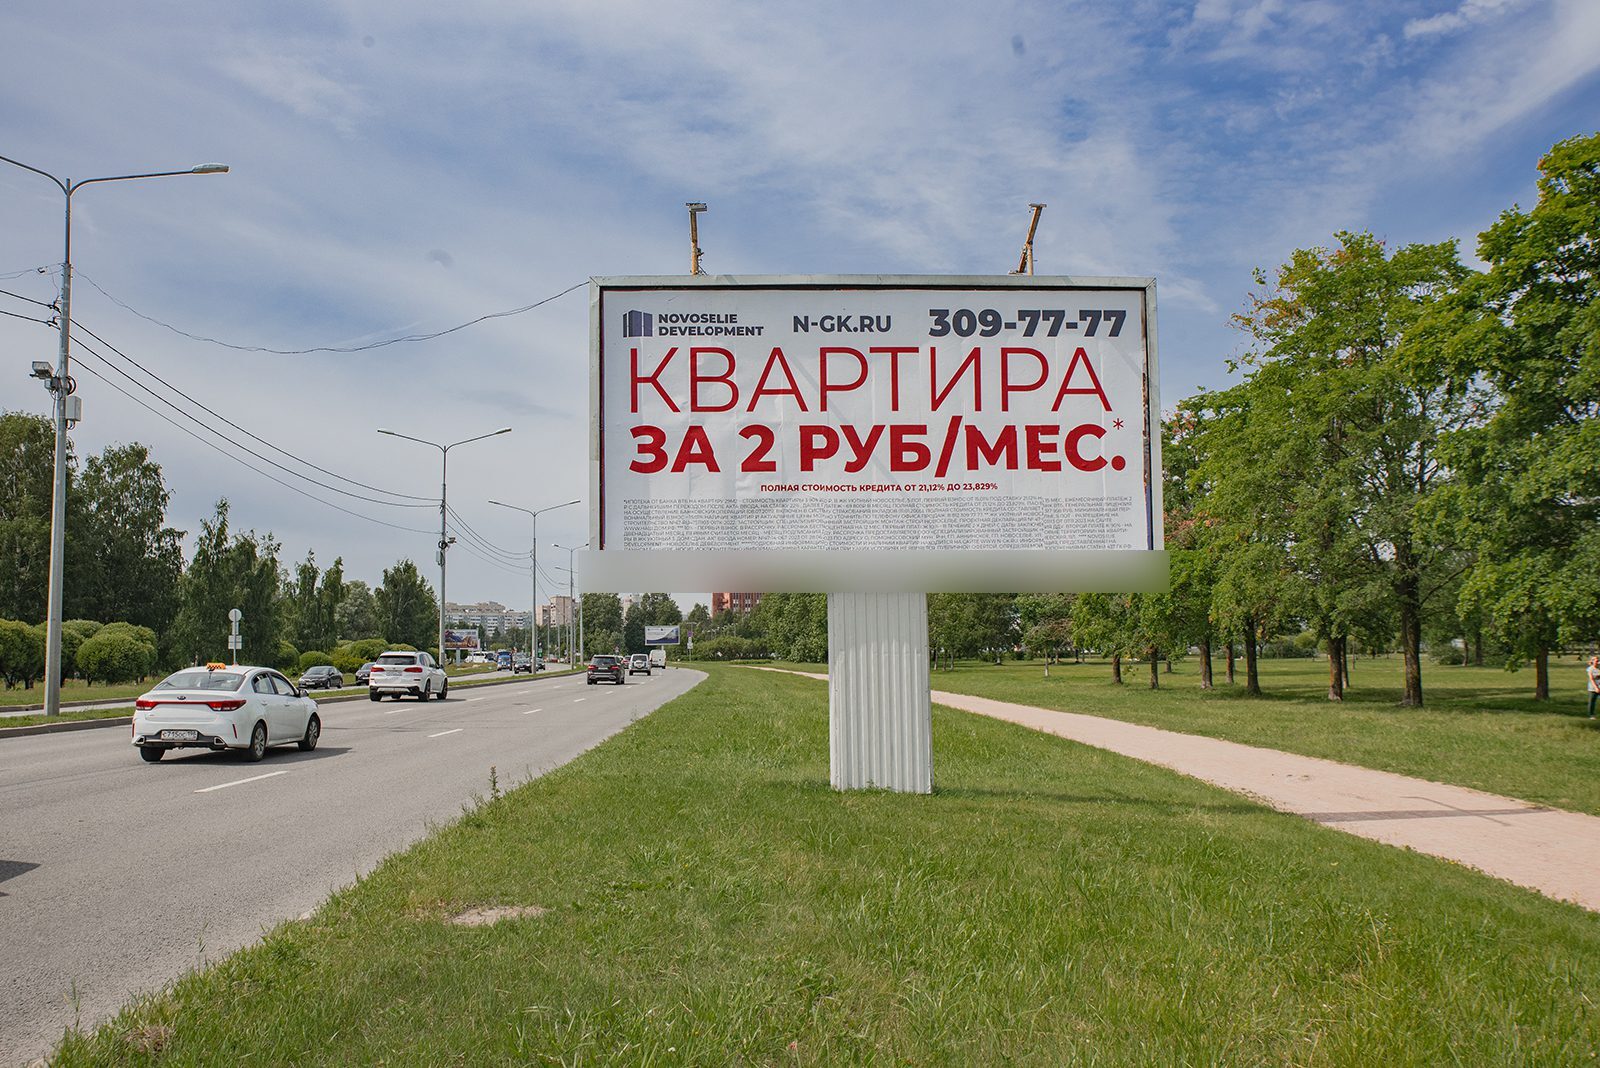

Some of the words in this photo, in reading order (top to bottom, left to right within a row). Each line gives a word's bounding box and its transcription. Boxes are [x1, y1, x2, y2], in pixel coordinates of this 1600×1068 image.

[658, 313, 738, 324] NOVOSELIE
[793, 315, 891, 333] N-GK.RU
[928, 308, 1127, 338] 309-77-77
[658, 326, 764, 337] DEVELOPMENT
[630, 346, 1113, 413] КВАРТИРА
[629, 424, 721, 474] ЗА
[738, 424, 777, 473] 2
[760, 484, 800, 493] ПОЛНАЯ
[801, 484, 857, 493] СТОИМОСТЬ
[859, 484, 902, 493] КРЕДИТА
[904, 484, 917, 492] ОТ
[918, 483, 945, 493] 21,12%
[946, 483, 961, 492] ДО
[962, 482, 999, 492] 23,829%
